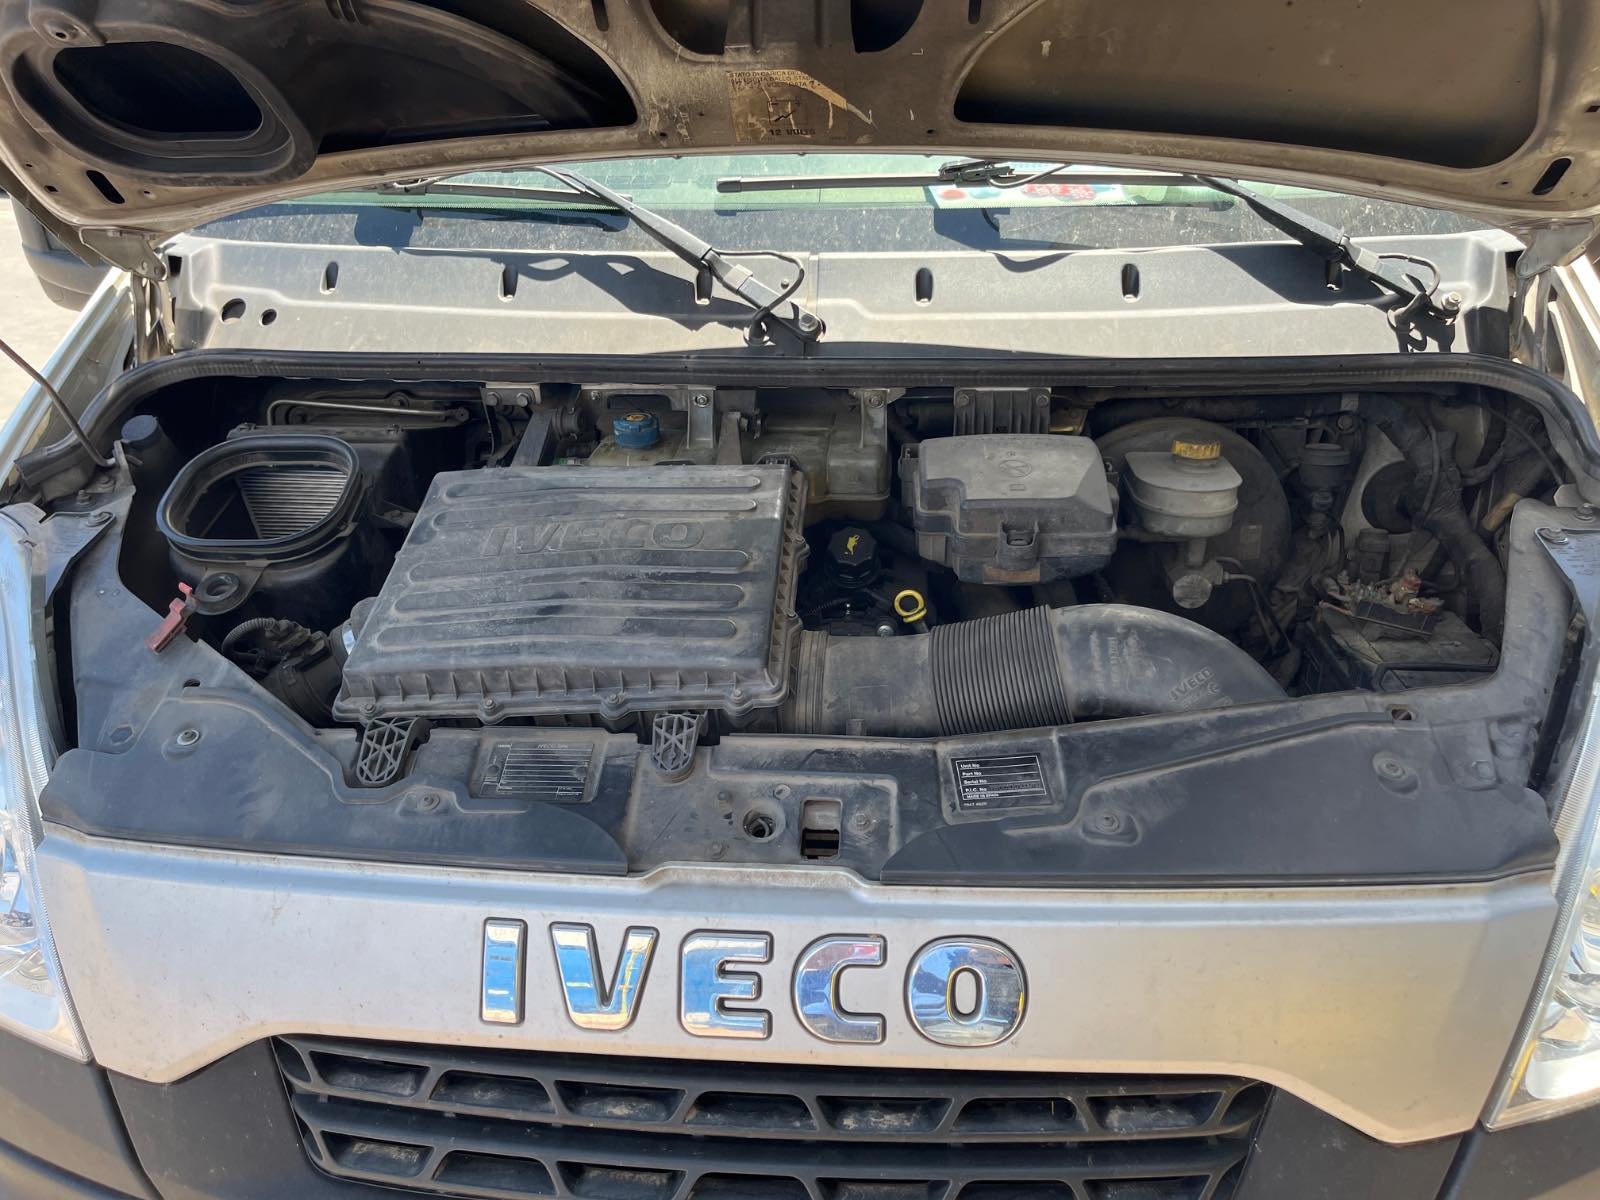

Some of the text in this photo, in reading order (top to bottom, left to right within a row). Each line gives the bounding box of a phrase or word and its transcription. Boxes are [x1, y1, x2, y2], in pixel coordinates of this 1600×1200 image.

[482, 518, 705, 557] IVECO
[1168, 667, 1215, 701] IVECO
[480, 917, 1029, 1048] IVECO
